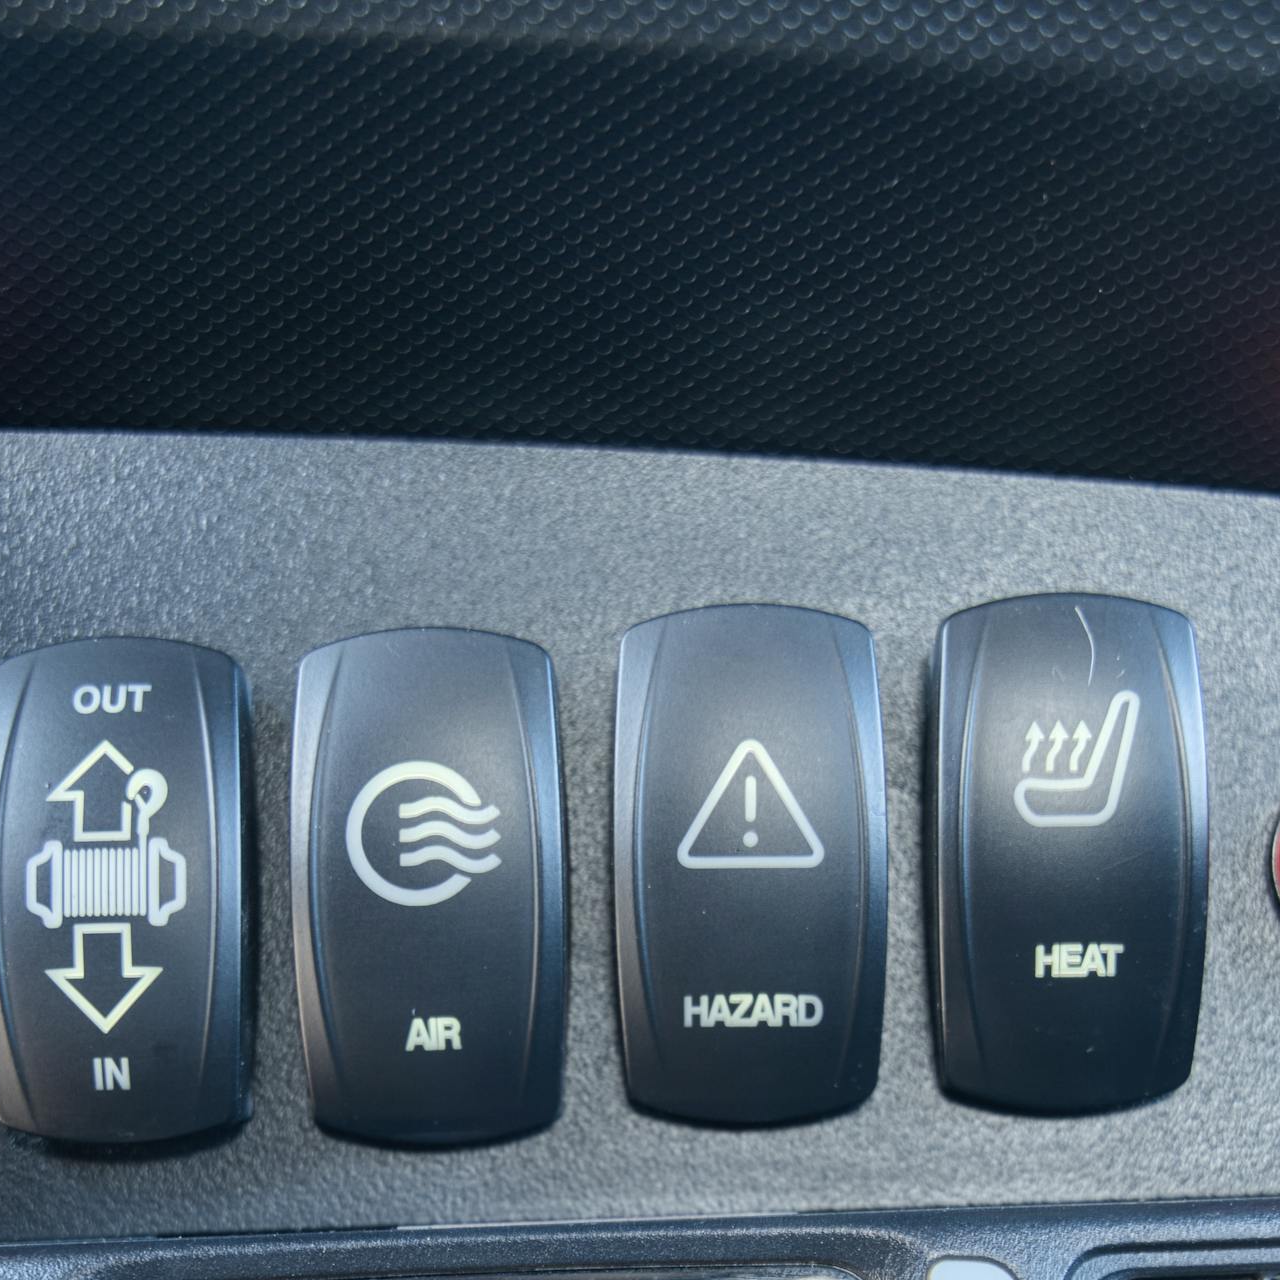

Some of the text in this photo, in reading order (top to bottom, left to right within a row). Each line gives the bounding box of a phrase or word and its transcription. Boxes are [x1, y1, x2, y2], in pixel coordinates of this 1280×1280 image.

[72, 684, 152, 715] OUT
[1034, 943, 1125, 979] HEAT
[683, 994, 824, 1028] HAZARD
[405, 1016, 463, 1052] AIR
[92, 1057, 132, 1091] IN
